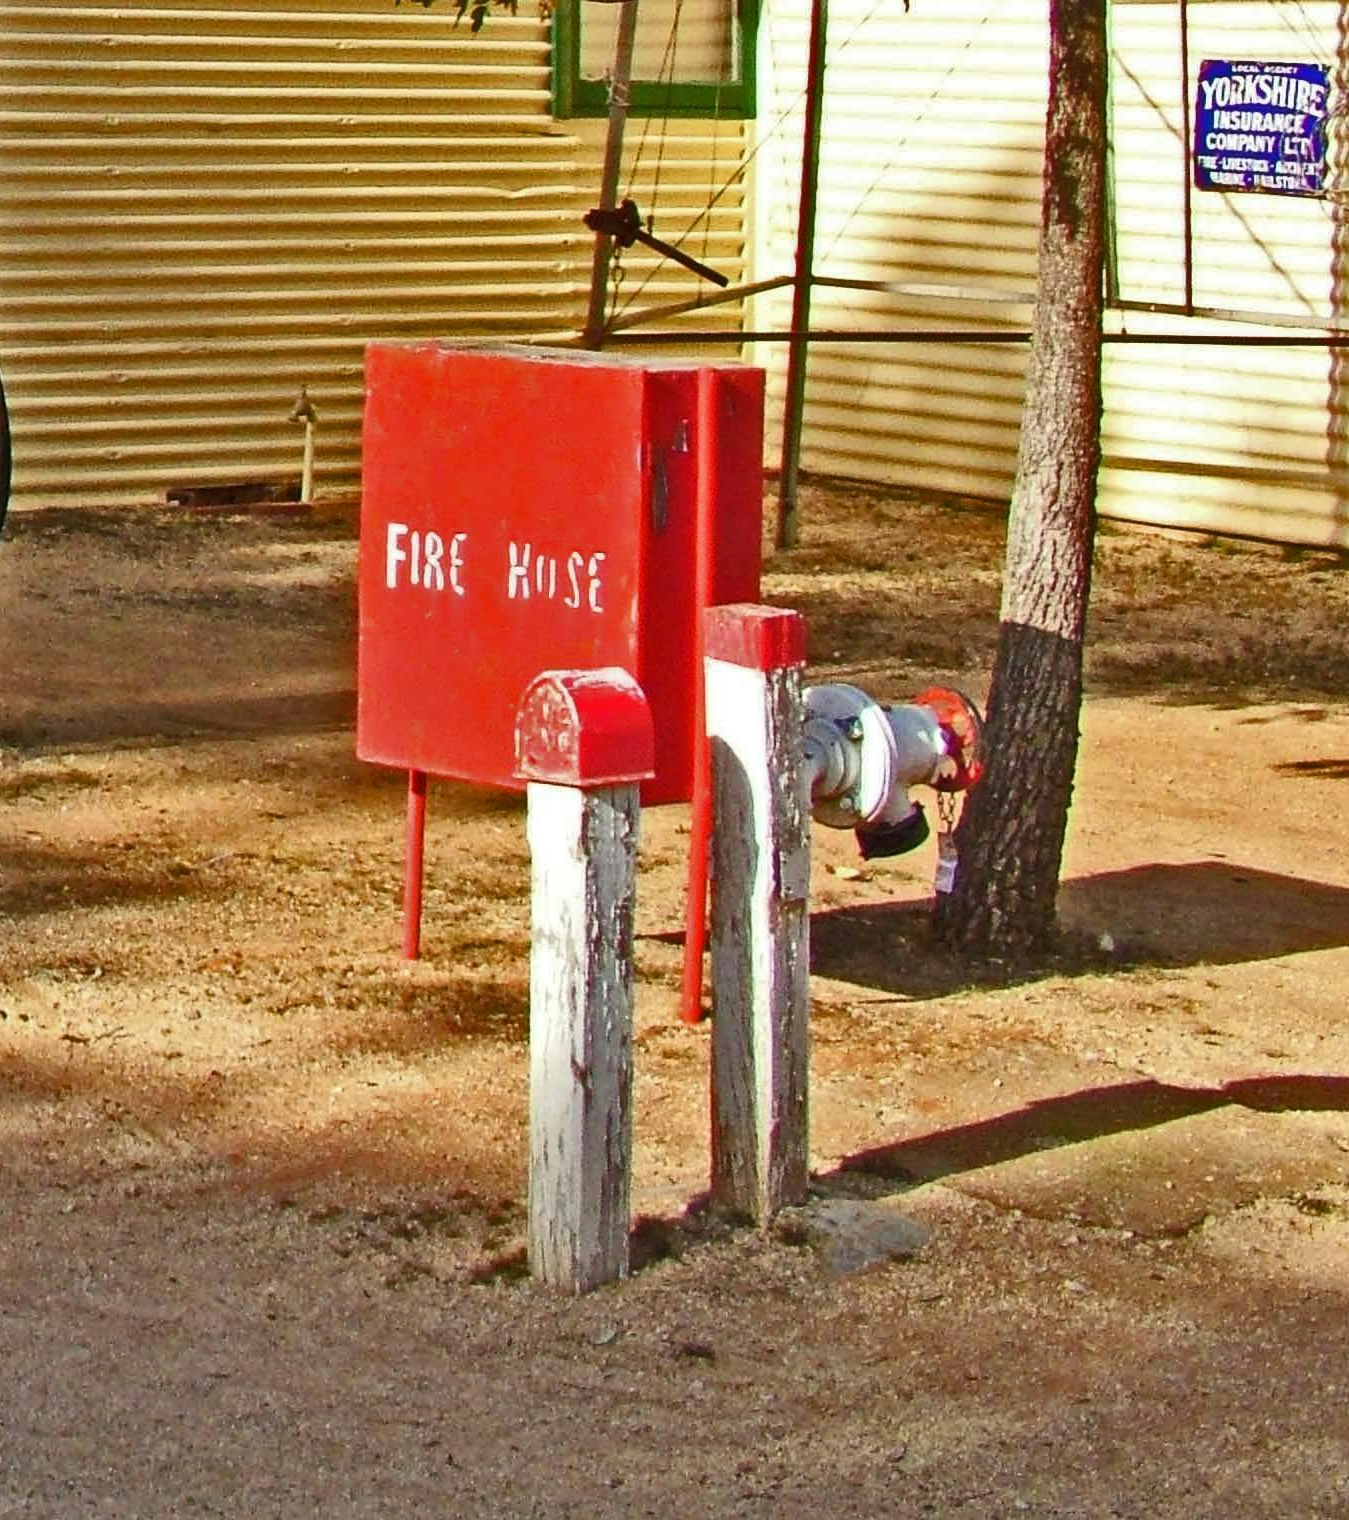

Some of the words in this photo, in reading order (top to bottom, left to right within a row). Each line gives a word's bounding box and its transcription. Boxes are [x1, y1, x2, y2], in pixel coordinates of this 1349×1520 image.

[1202, 74, 1325, 118] YORKSHIRE
[1213, 110, 1305, 135] INSURANCE
[1206, 132, 1276, 153] COMPANY
[386, 522, 467, 596] FIRE
